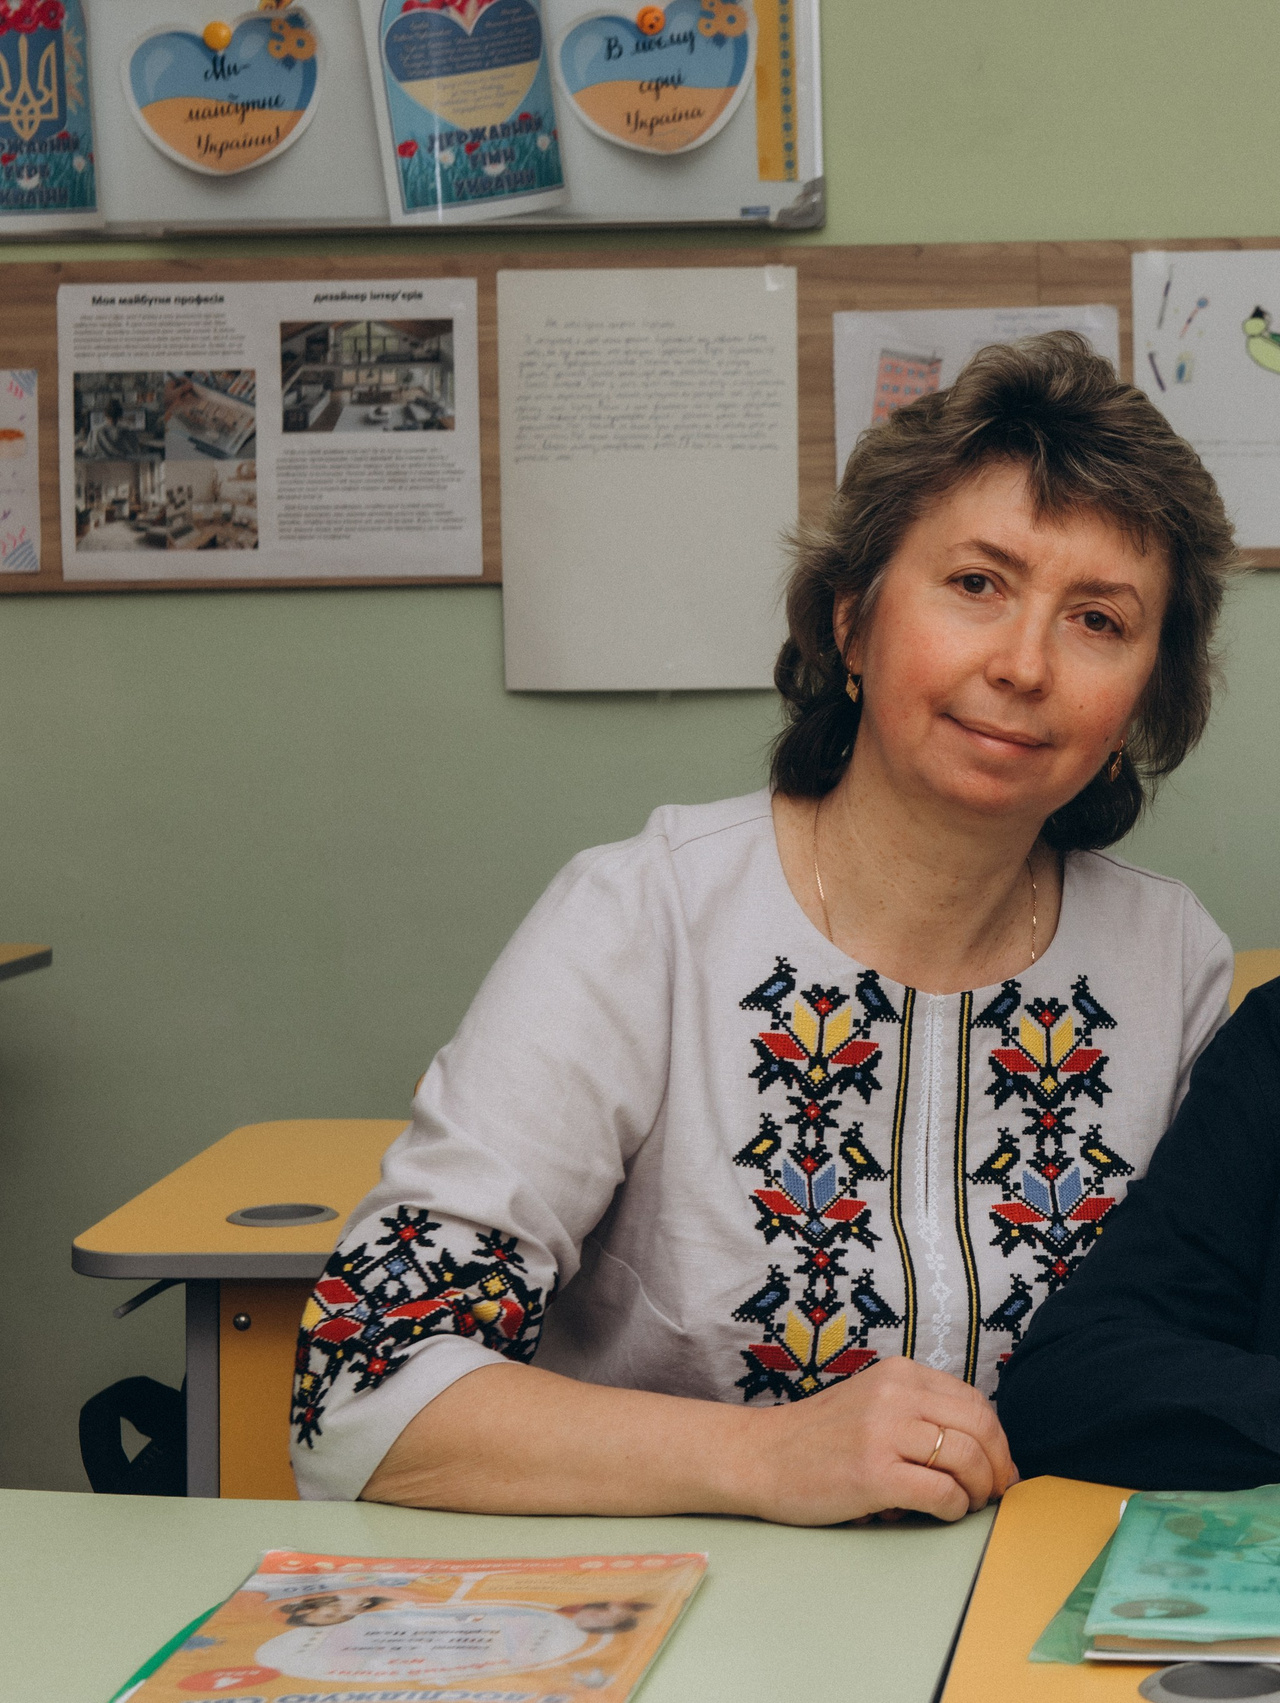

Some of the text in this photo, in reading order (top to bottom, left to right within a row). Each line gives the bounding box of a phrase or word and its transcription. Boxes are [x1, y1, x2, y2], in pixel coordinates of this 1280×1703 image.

[604, 35, 624, 61] В
[626, 106, 704, 137] Україна
[91, 293, 225, 307] Моя майбутня професія
